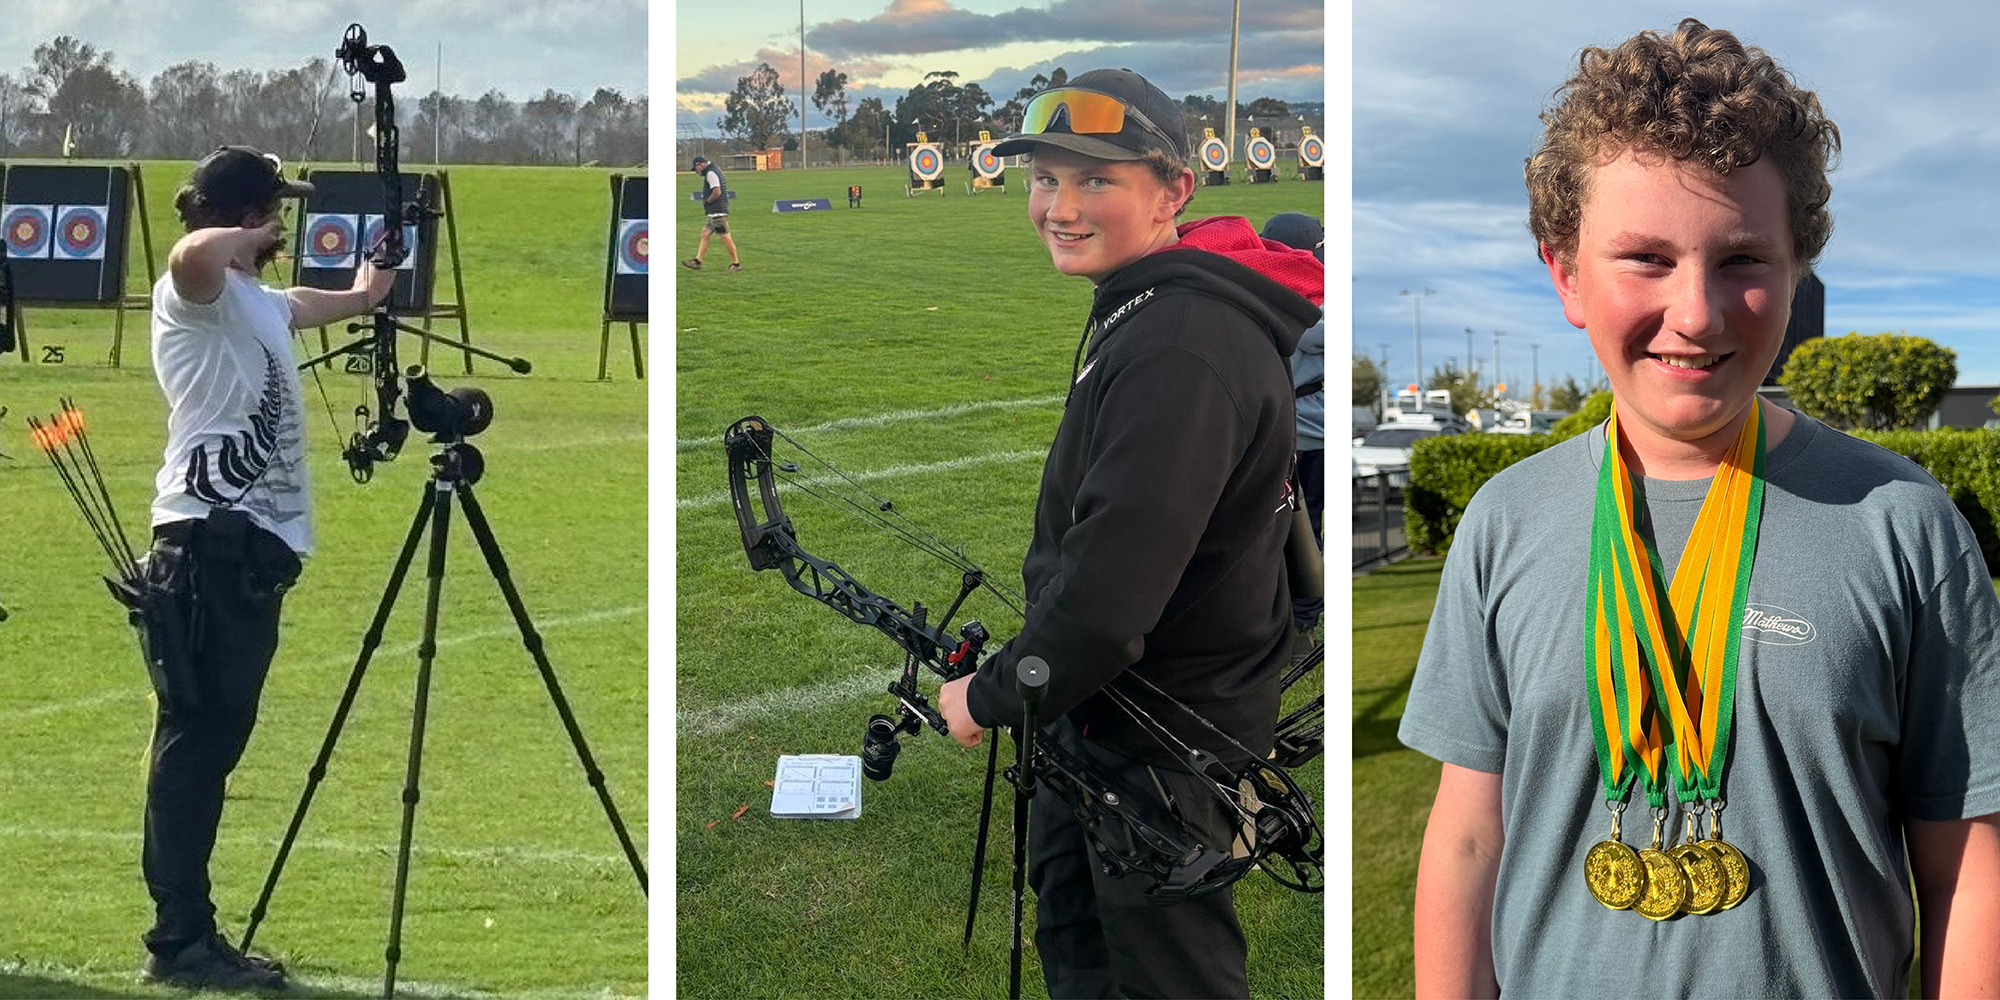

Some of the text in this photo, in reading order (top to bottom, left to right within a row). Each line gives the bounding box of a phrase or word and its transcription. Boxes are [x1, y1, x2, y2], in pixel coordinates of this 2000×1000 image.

[980, 132, 989, 141] 17
[1103, 287, 1155, 329] VORTEX
[41, 346, 65, 364] 25
[1742, 608, 1806, 635] Mathews
